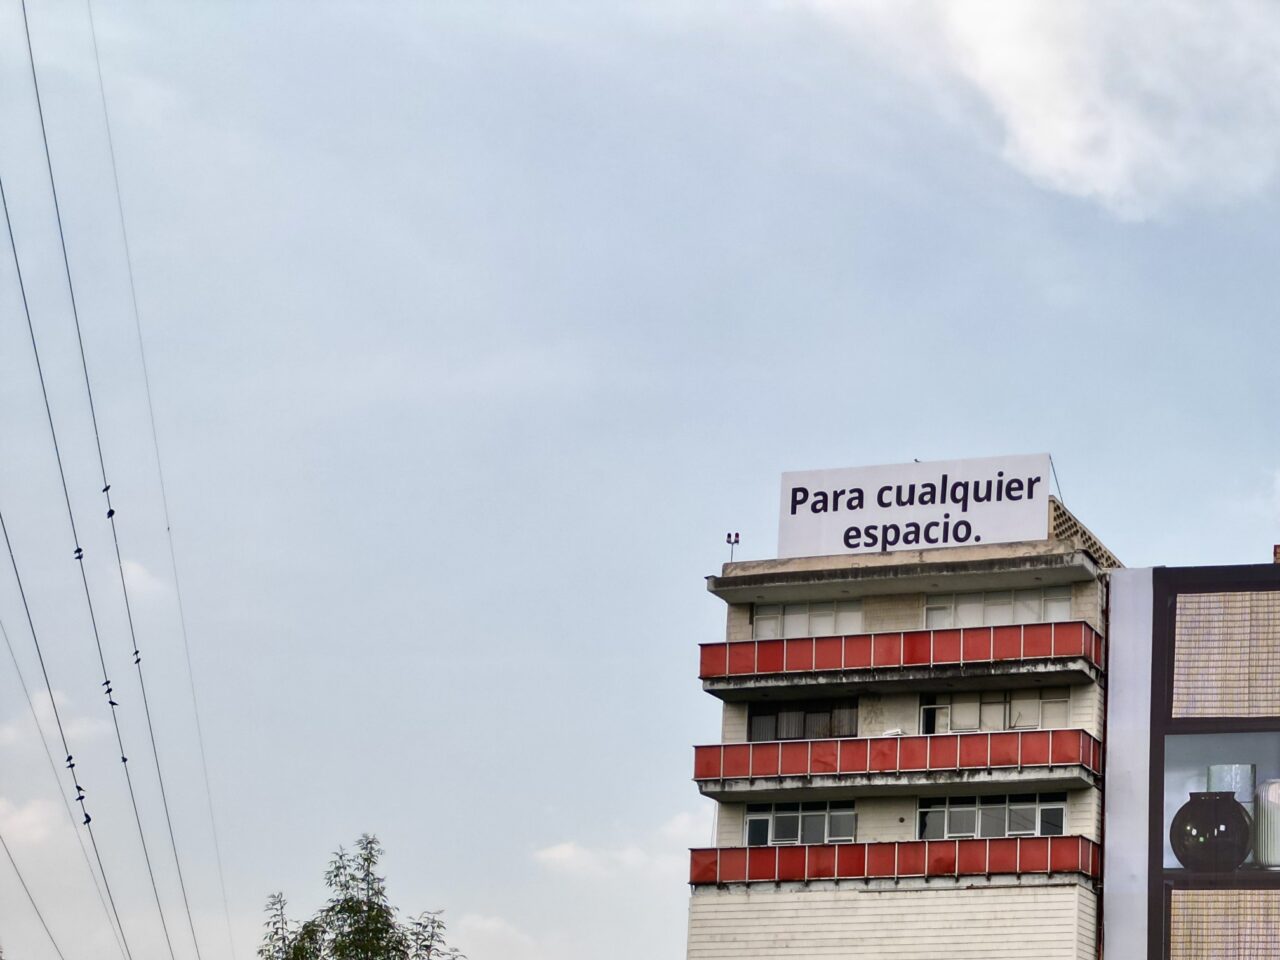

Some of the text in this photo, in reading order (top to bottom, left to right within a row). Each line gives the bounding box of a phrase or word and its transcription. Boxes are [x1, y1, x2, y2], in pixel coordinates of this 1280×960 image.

[790, 471, 1041, 515] Para cualquier
[843, 513, 981, 552] espacio.
